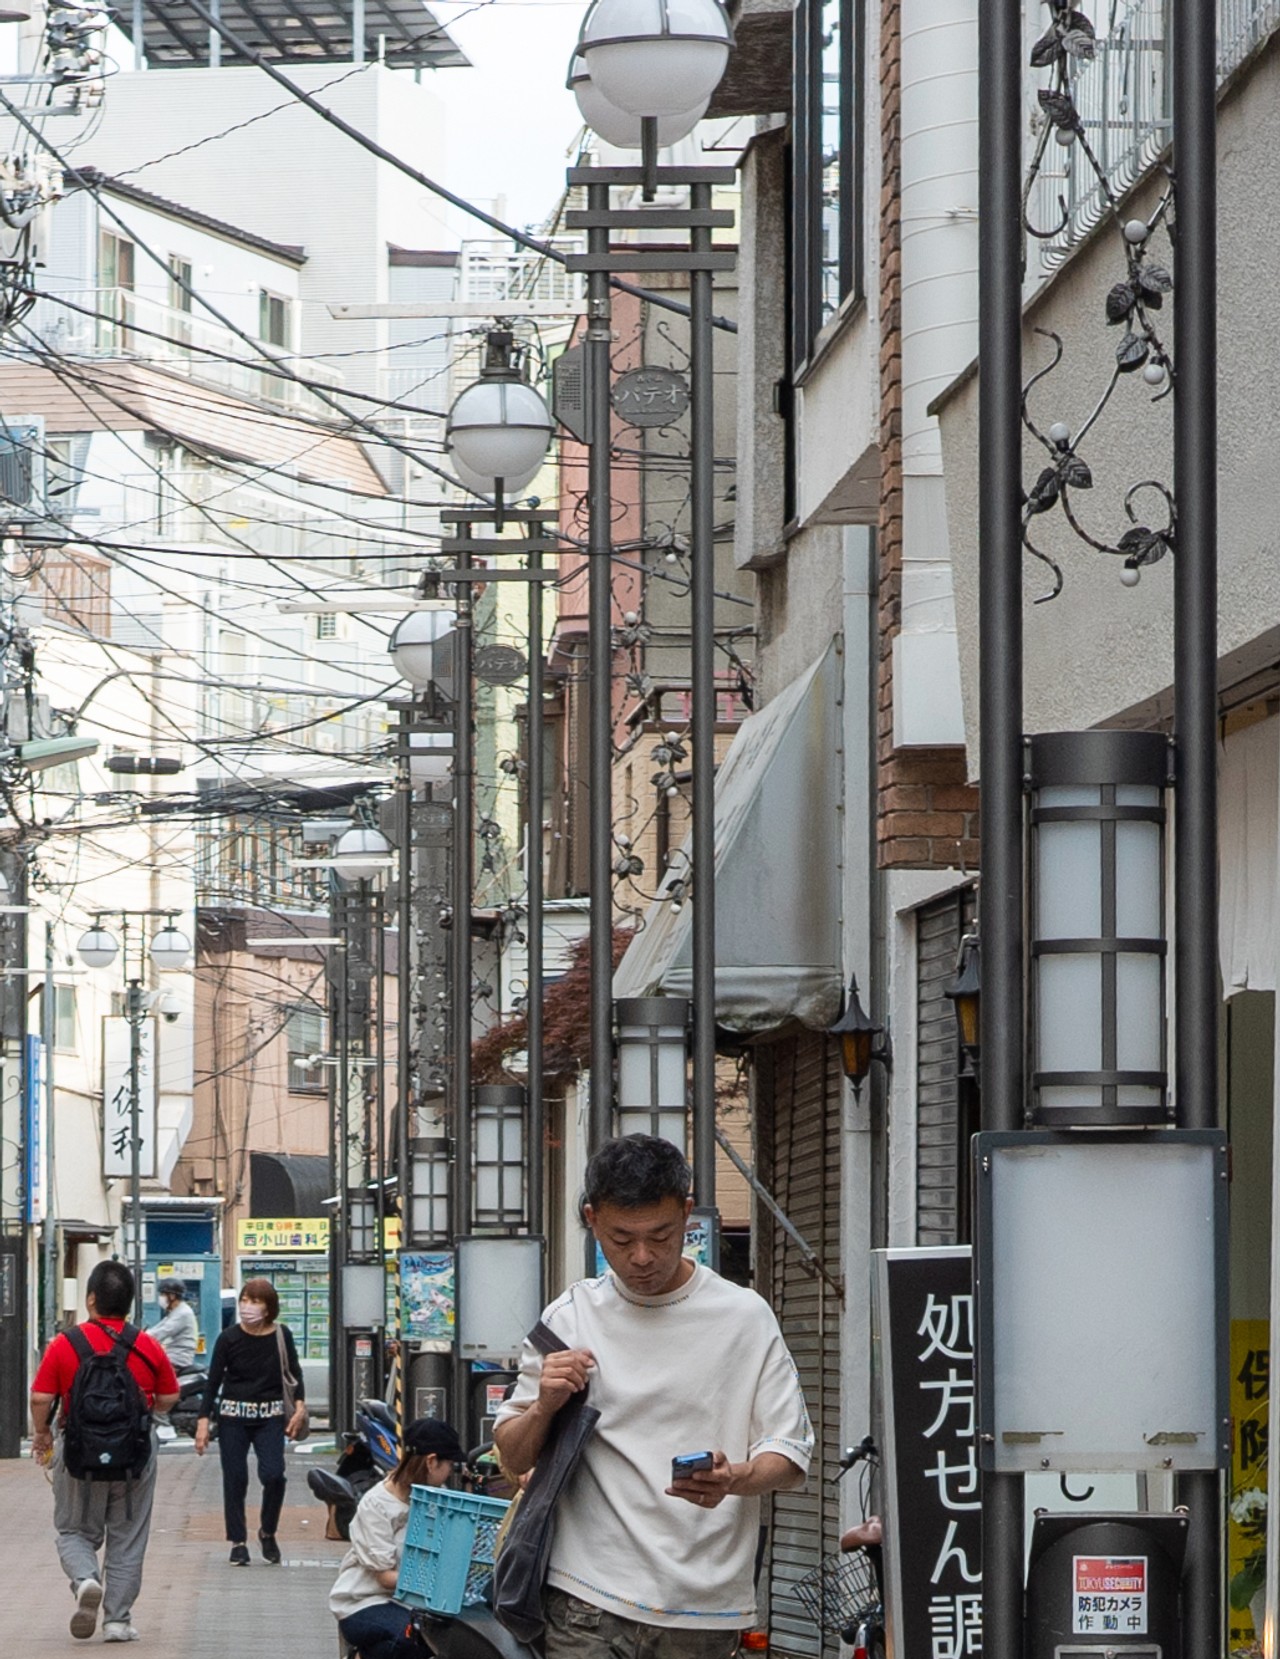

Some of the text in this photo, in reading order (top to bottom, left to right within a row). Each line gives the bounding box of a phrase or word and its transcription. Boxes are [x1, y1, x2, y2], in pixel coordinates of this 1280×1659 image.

[619, 384, 682, 404] パテオ
[1078, 1596, 1142, 1612] 防犯カメラ
